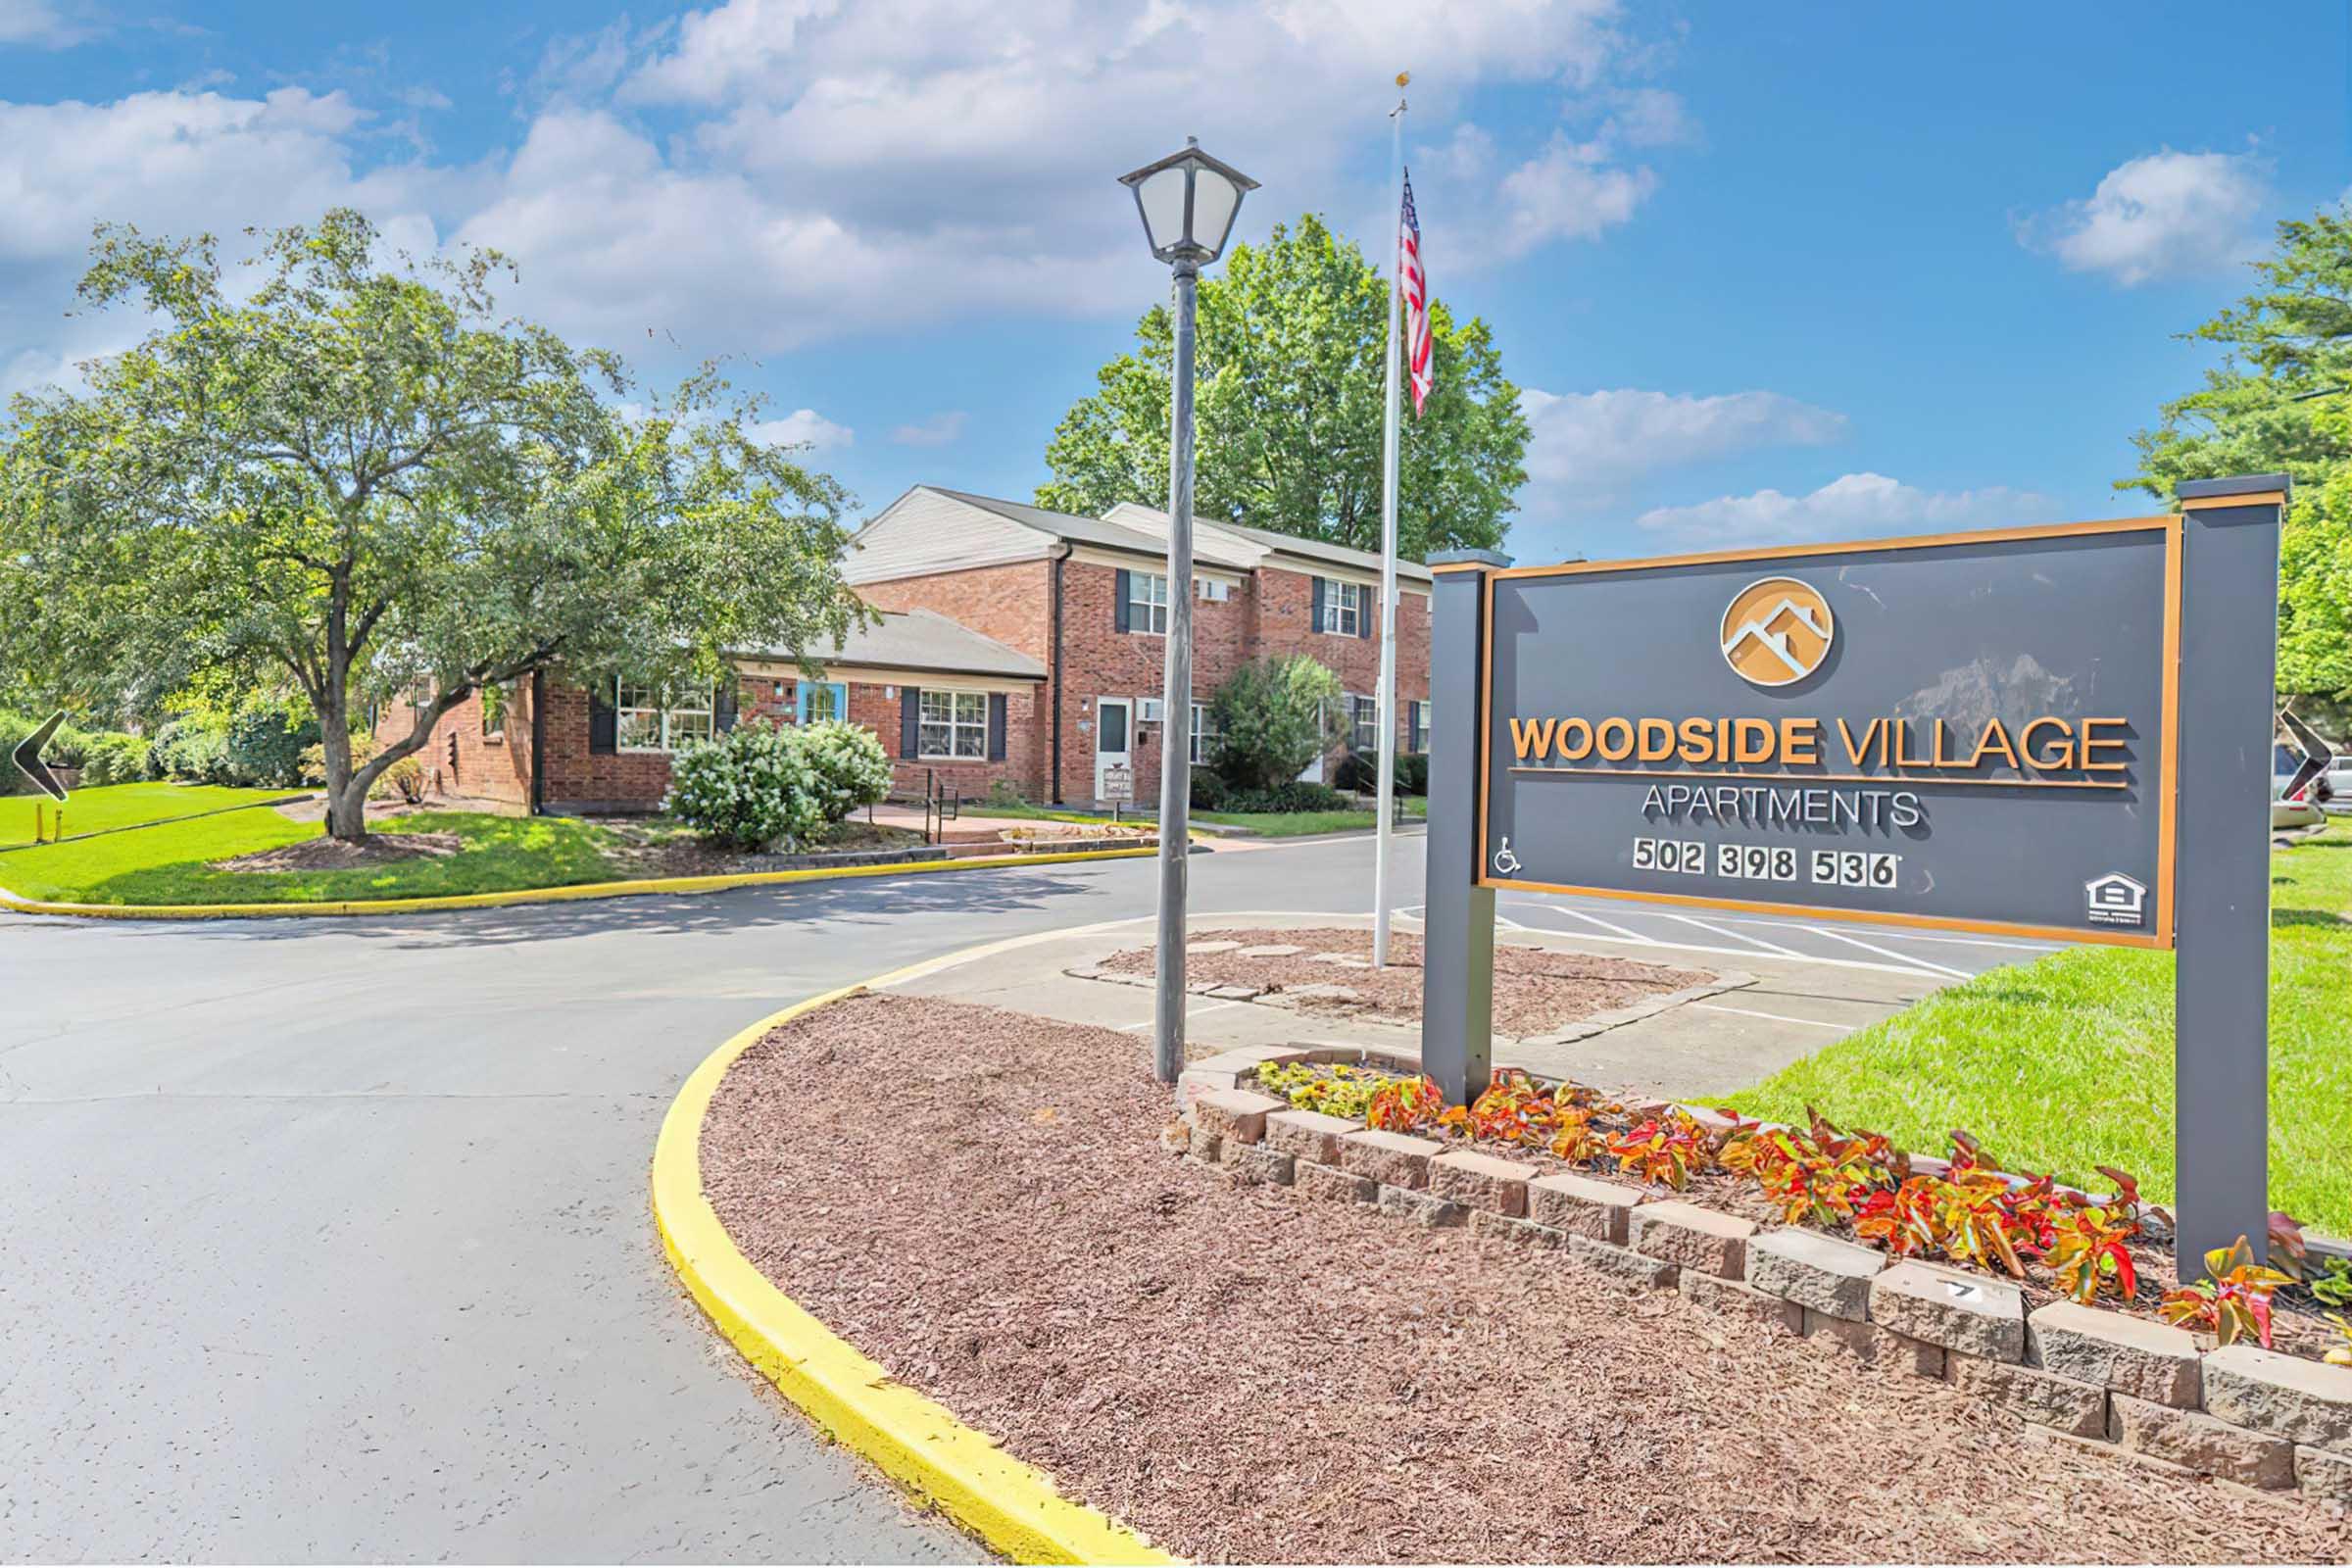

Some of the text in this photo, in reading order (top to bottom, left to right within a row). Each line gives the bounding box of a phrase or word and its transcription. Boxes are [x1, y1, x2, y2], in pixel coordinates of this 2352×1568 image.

[1509, 716, 2128, 770] WOODSIDE VILLAGE
[1641, 784, 1920, 826] APARTMENTS
[1635, 840, 1894, 885] 502 398 536
